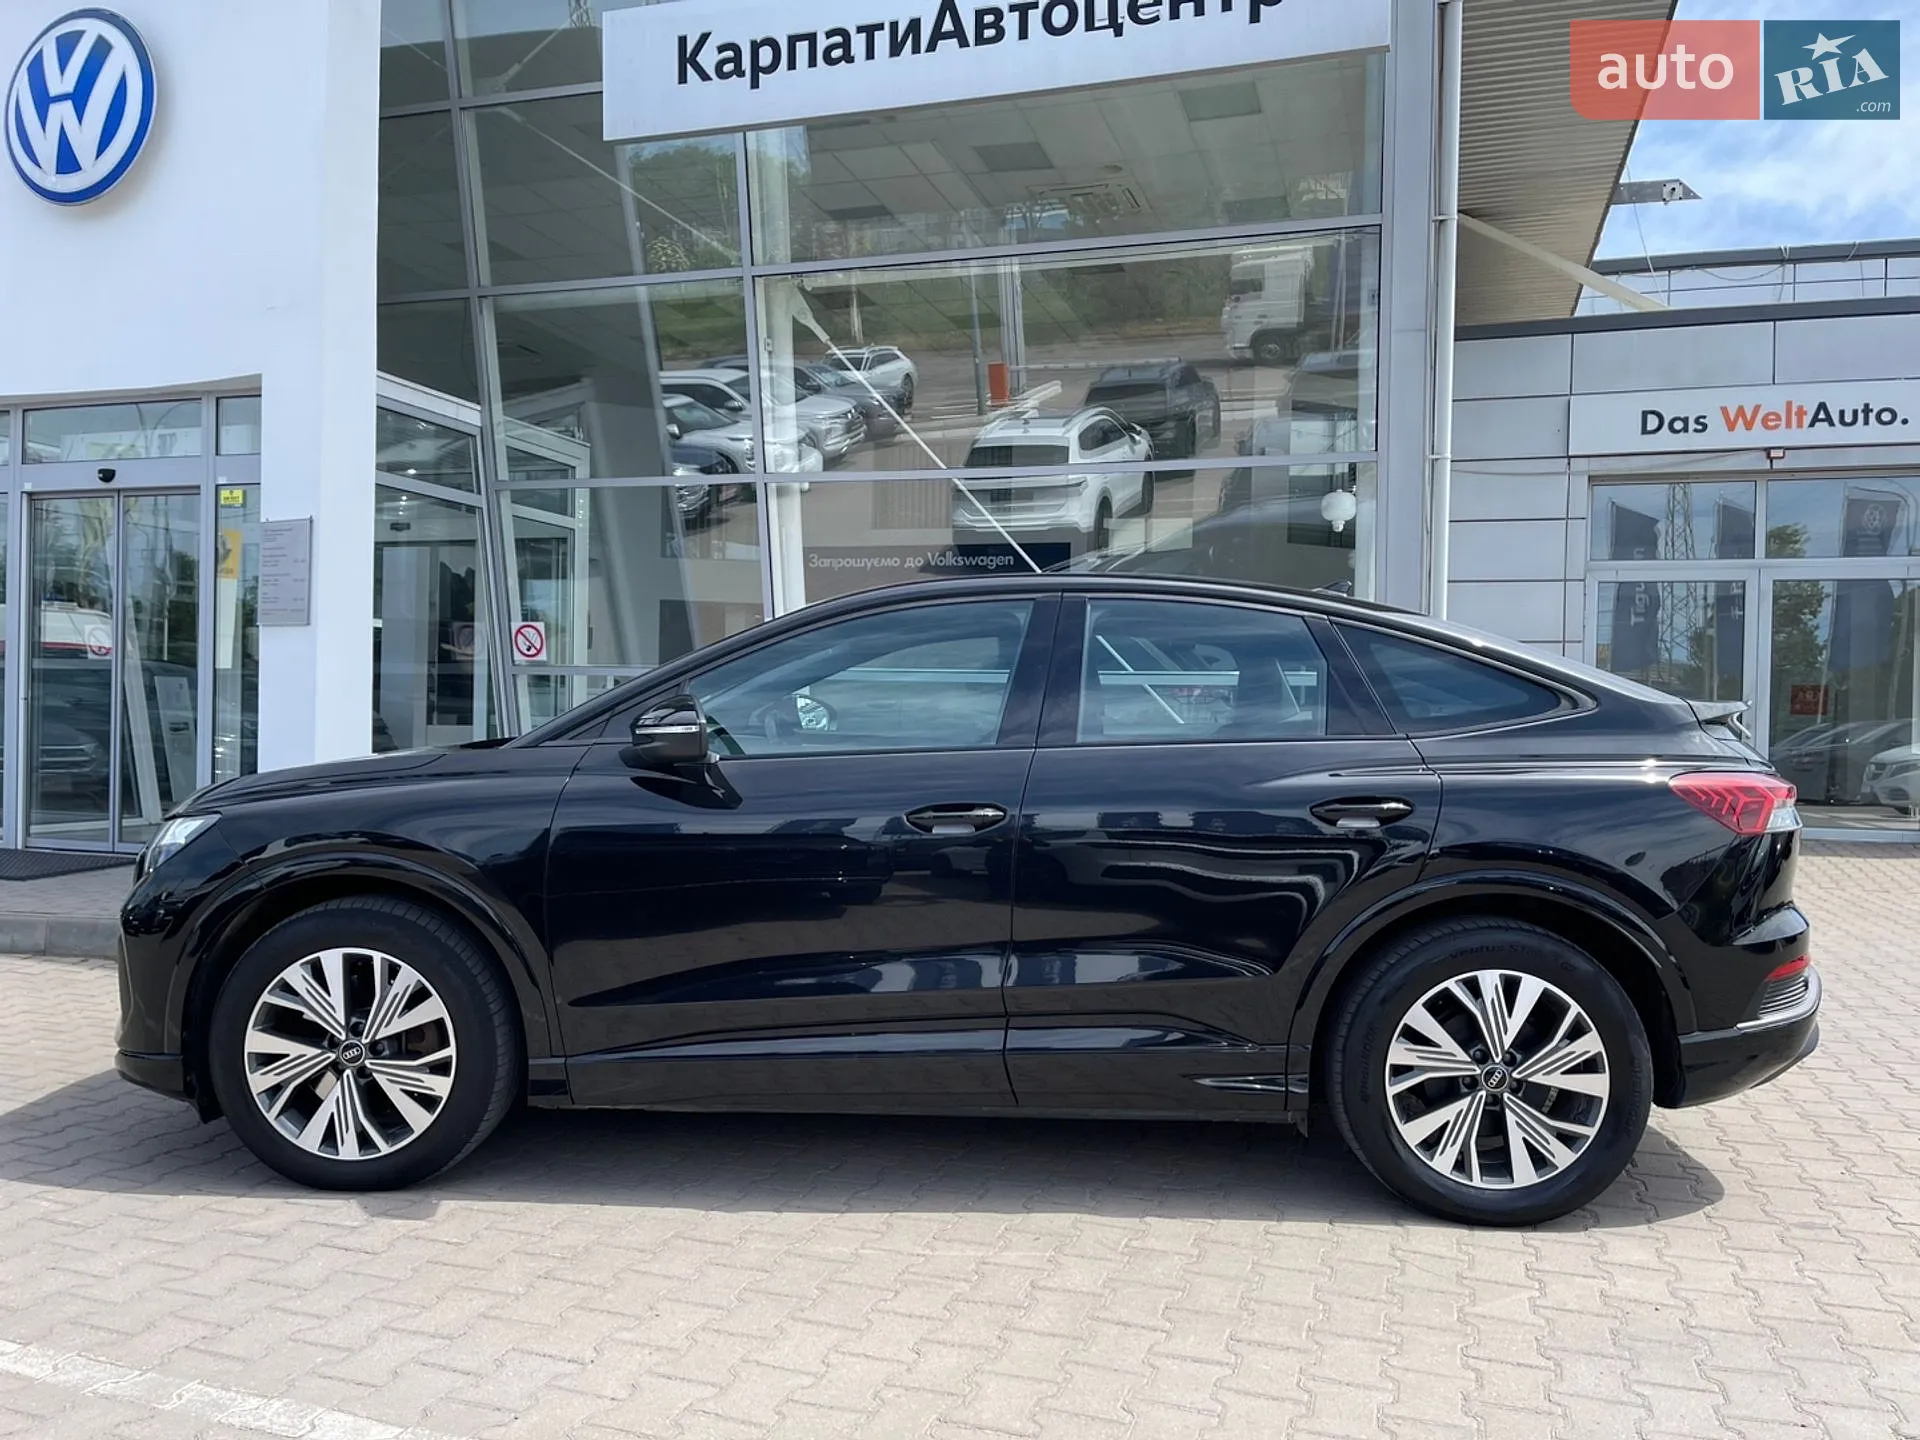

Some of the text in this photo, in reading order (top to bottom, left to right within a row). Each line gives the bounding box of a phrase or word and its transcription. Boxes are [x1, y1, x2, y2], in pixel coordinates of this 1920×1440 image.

[1640, 400, 1910, 436] Das WeltAuto.
[808, 551, 1015, 572] Запрошуємо до Volkswagen
